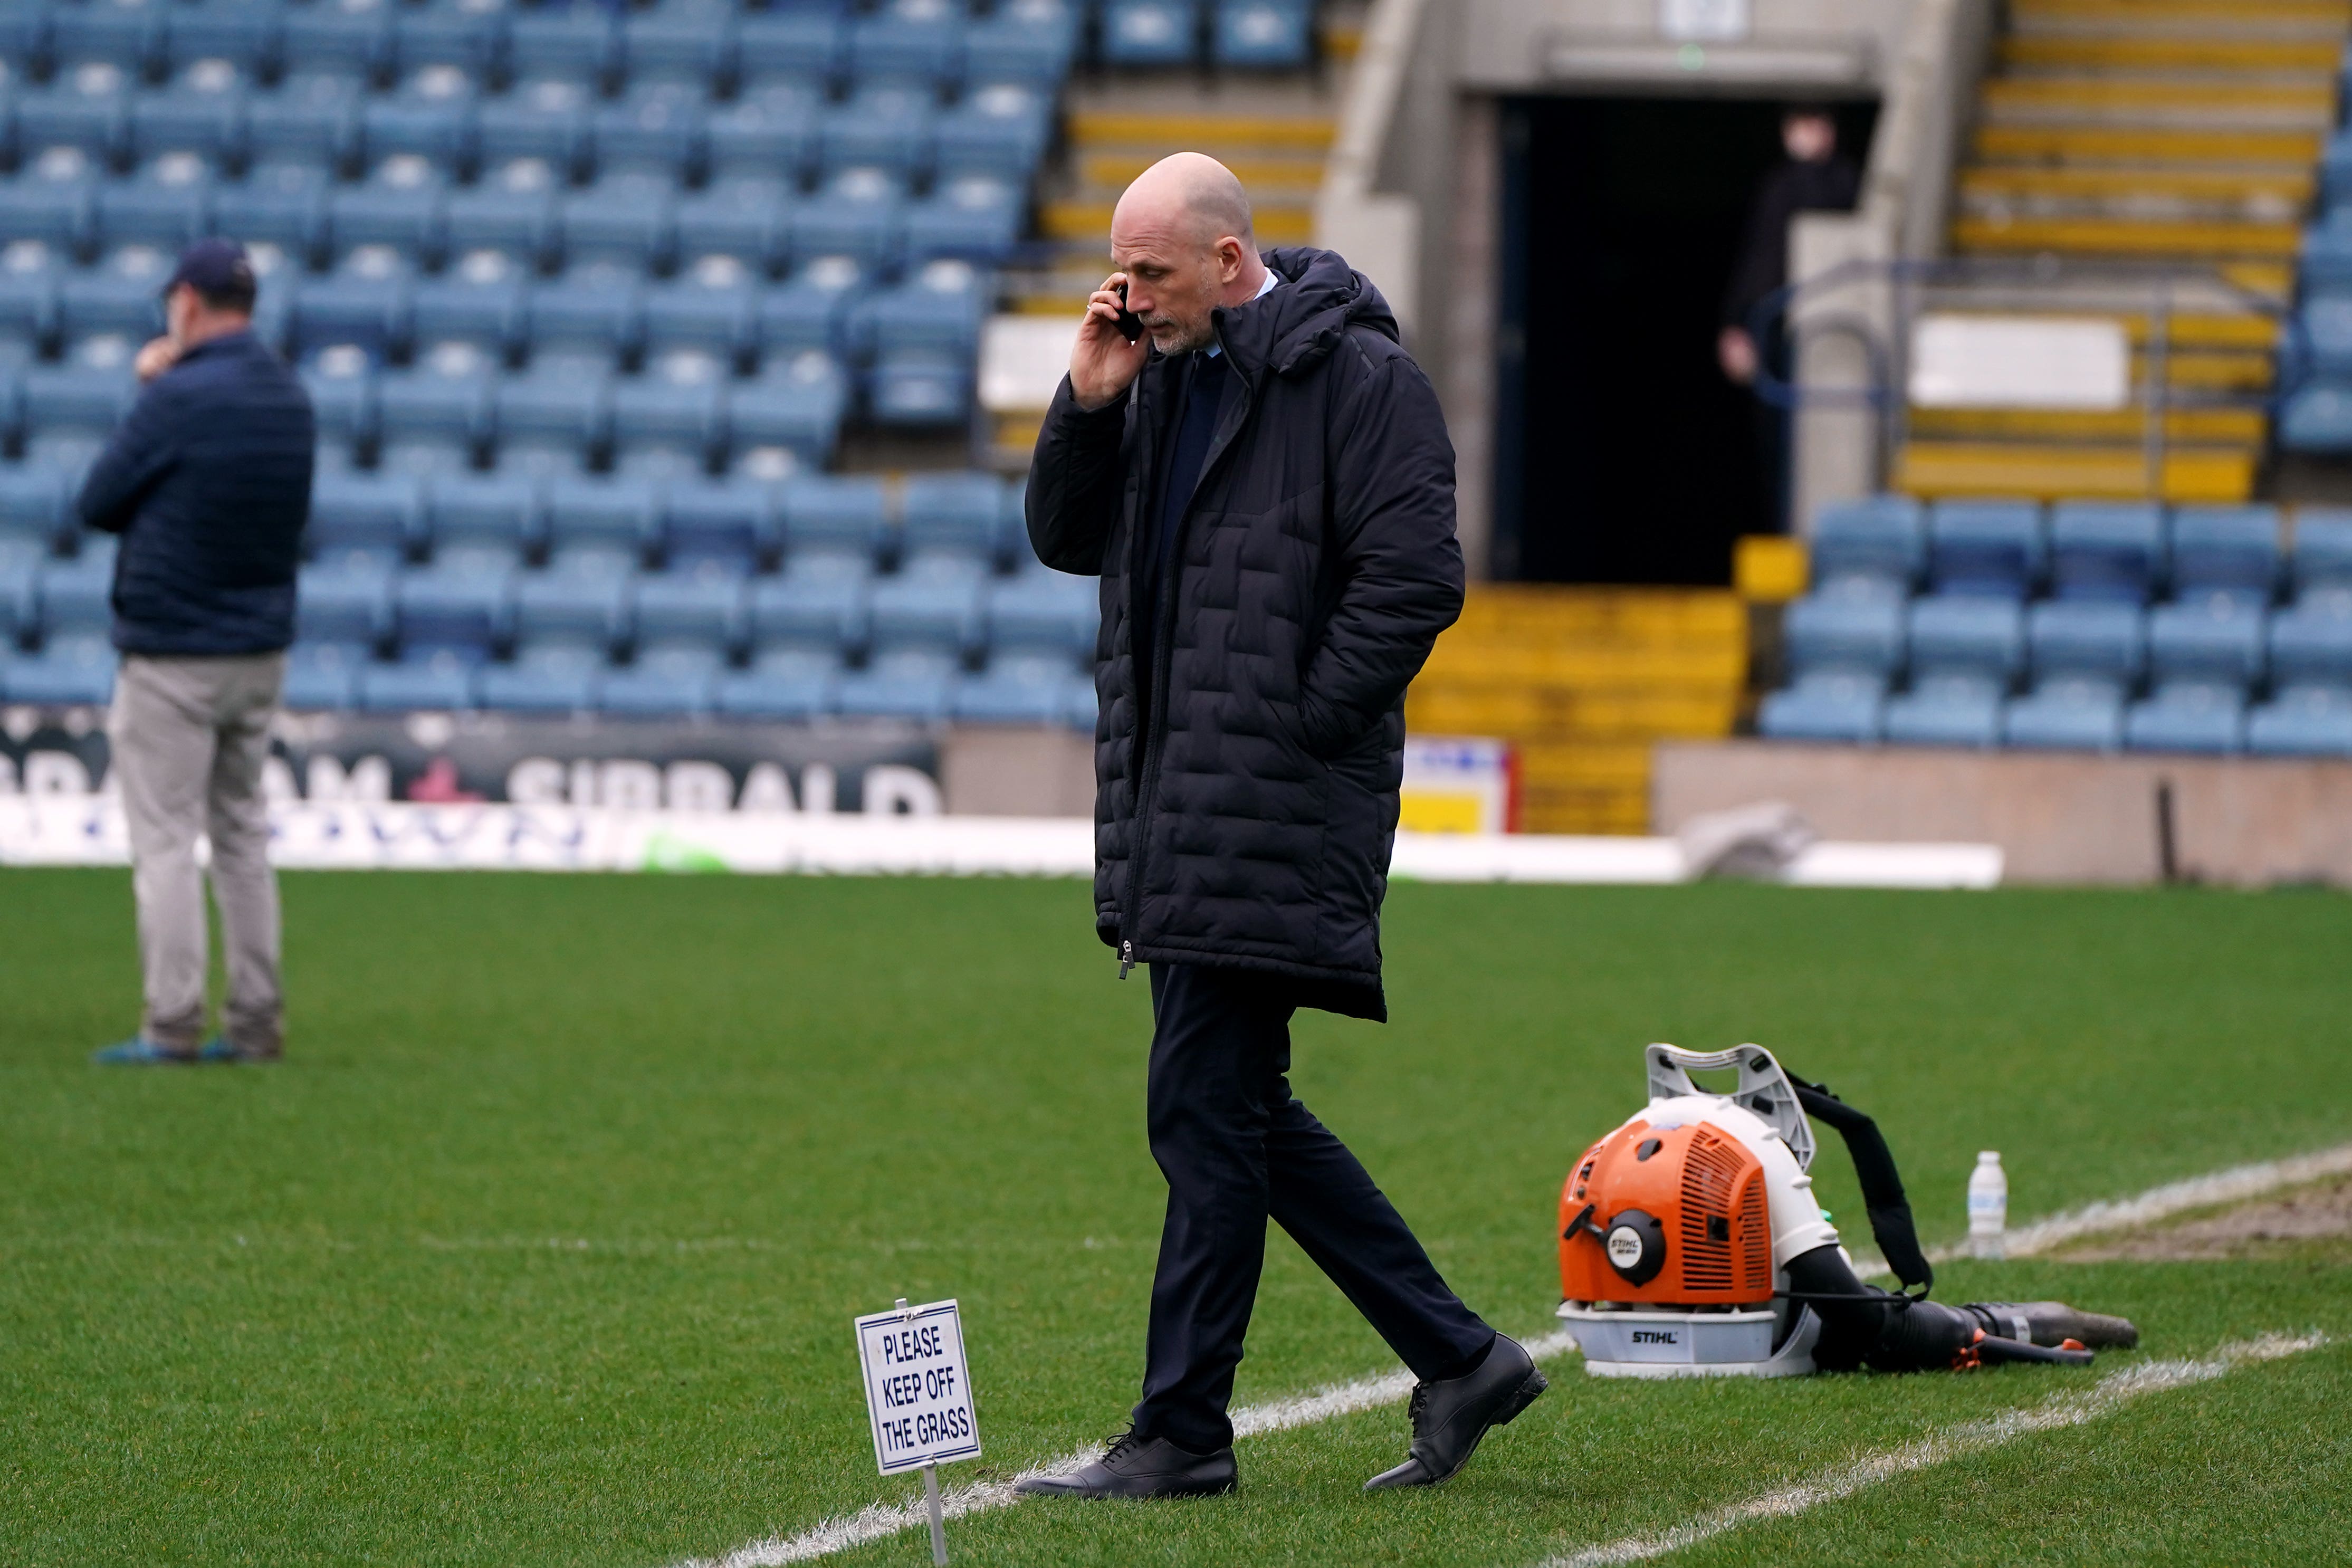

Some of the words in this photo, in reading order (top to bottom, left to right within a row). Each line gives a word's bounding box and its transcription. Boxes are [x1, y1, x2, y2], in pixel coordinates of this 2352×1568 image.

[883, 1326, 942, 1364] PLEASE
[1632, 1332, 1677, 1343] STIHL
[883, 1373, 921, 1408] KEEP
[926, 1366, 954, 1400] OFF
[883, 1418, 914, 1451] THE
[917, 1407, 969, 1445] GRASS
